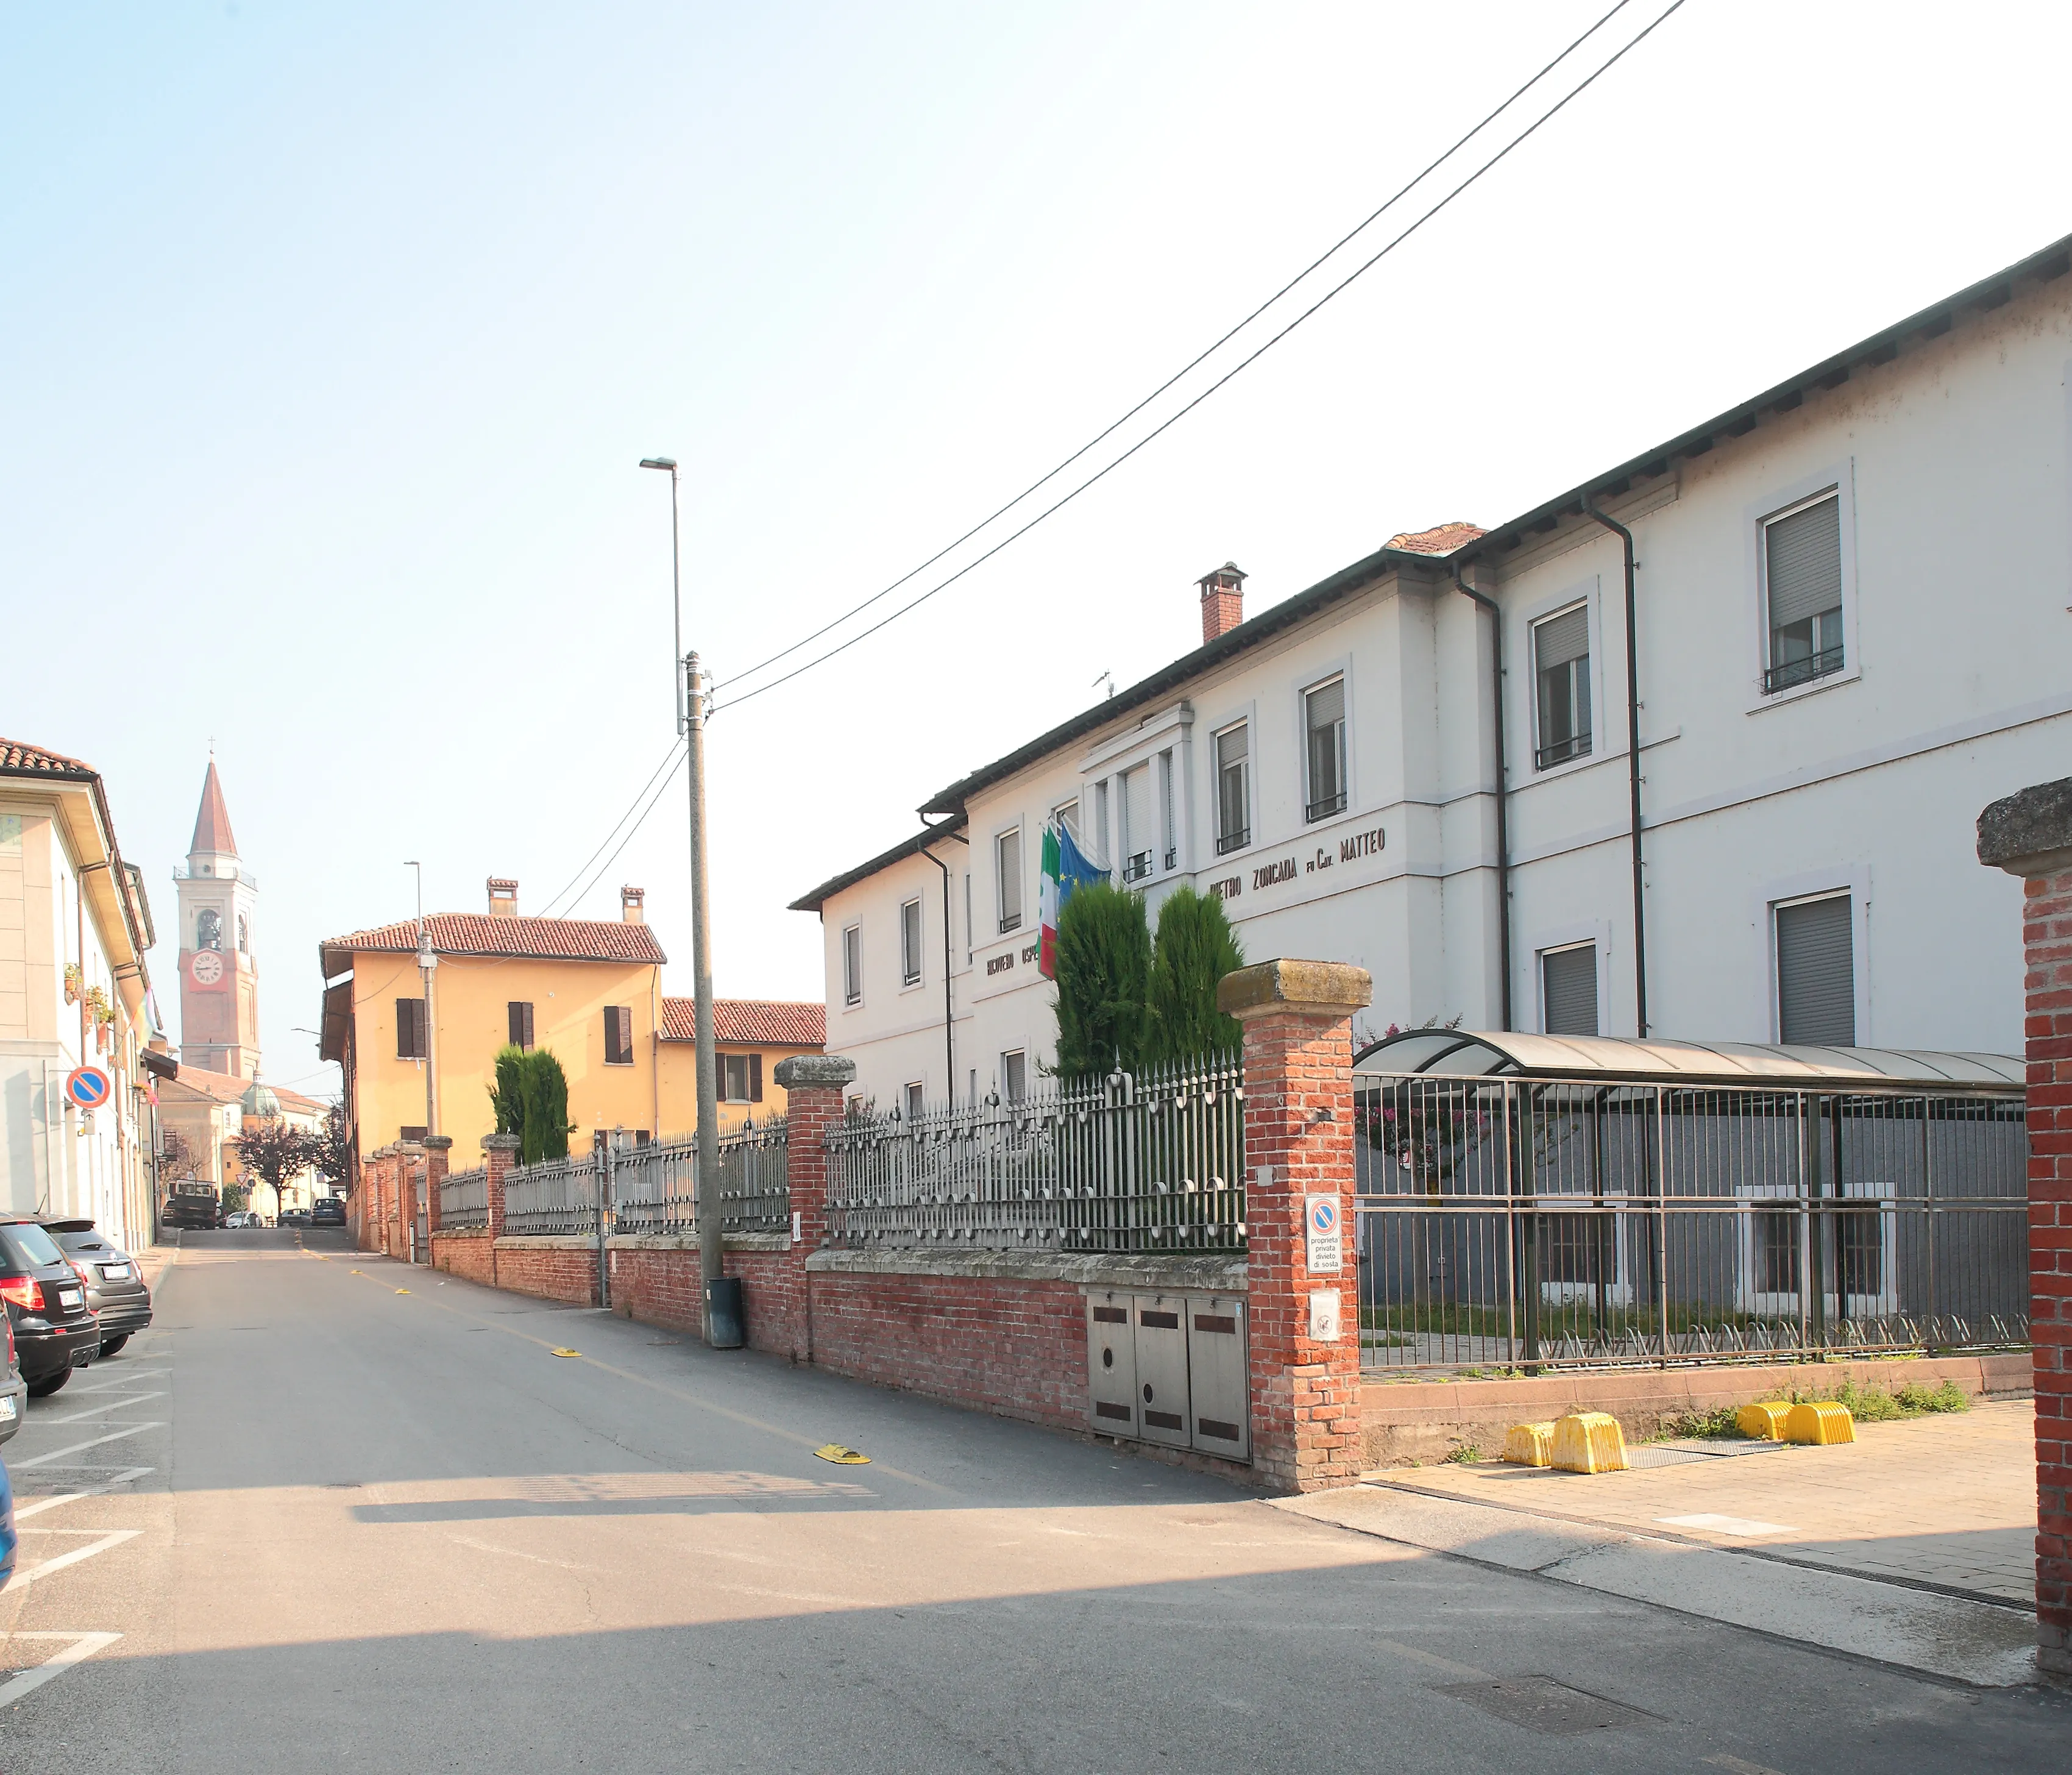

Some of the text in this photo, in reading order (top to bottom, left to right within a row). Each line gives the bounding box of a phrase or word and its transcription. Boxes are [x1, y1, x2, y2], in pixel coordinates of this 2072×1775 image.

[1252, 856, 1297, 891] ZONCADA
[1340, 827, 1385, 863] MATTEO
[987, 952, 1014, 976] RICOVERO
[1315, 1245, 1336, 1253] privata
